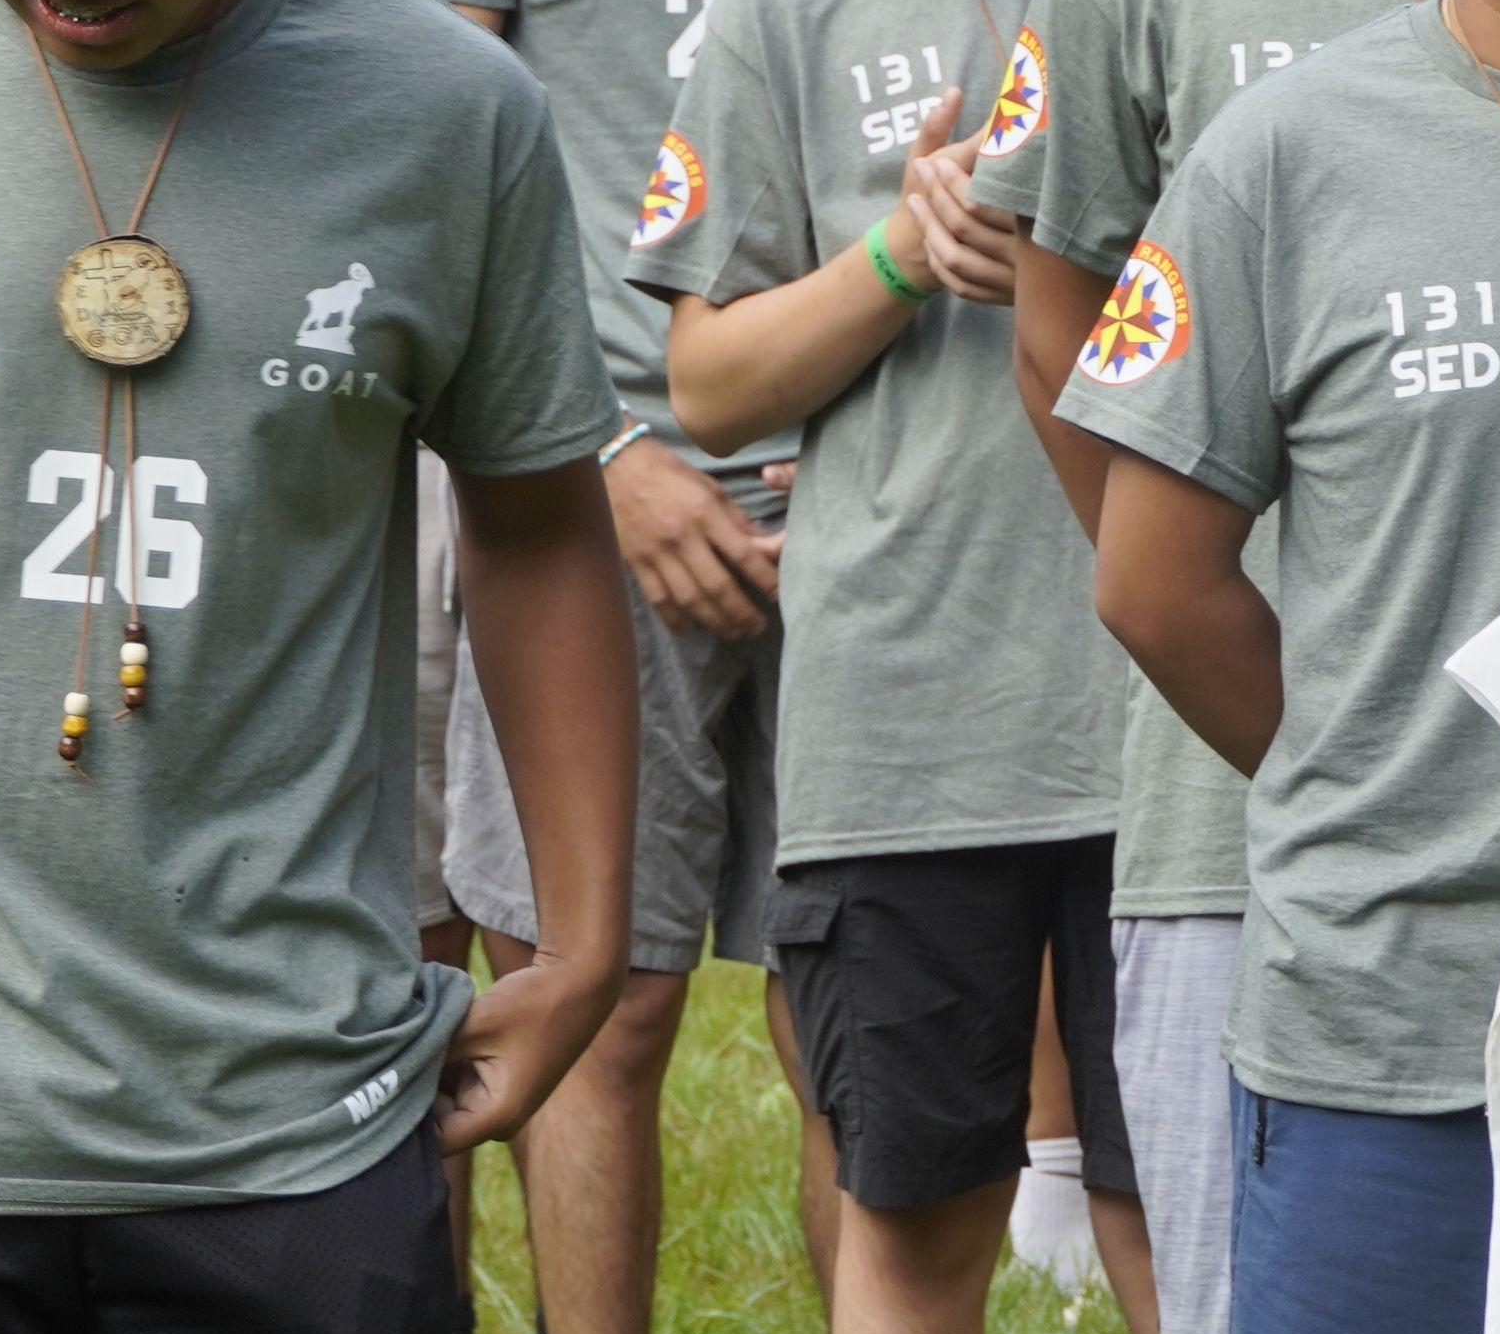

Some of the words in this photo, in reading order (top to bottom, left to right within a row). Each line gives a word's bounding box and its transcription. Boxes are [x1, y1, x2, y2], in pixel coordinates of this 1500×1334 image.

[851, 46, 942, 104] 131
[1230, 40, 1324, 86] 13
[1385, 281, 1495, 336] 131
[259, 358, 379, 400] GOAT
[1389, 342, 1500, 399] SED
[19, 449, 209, 610] 26
